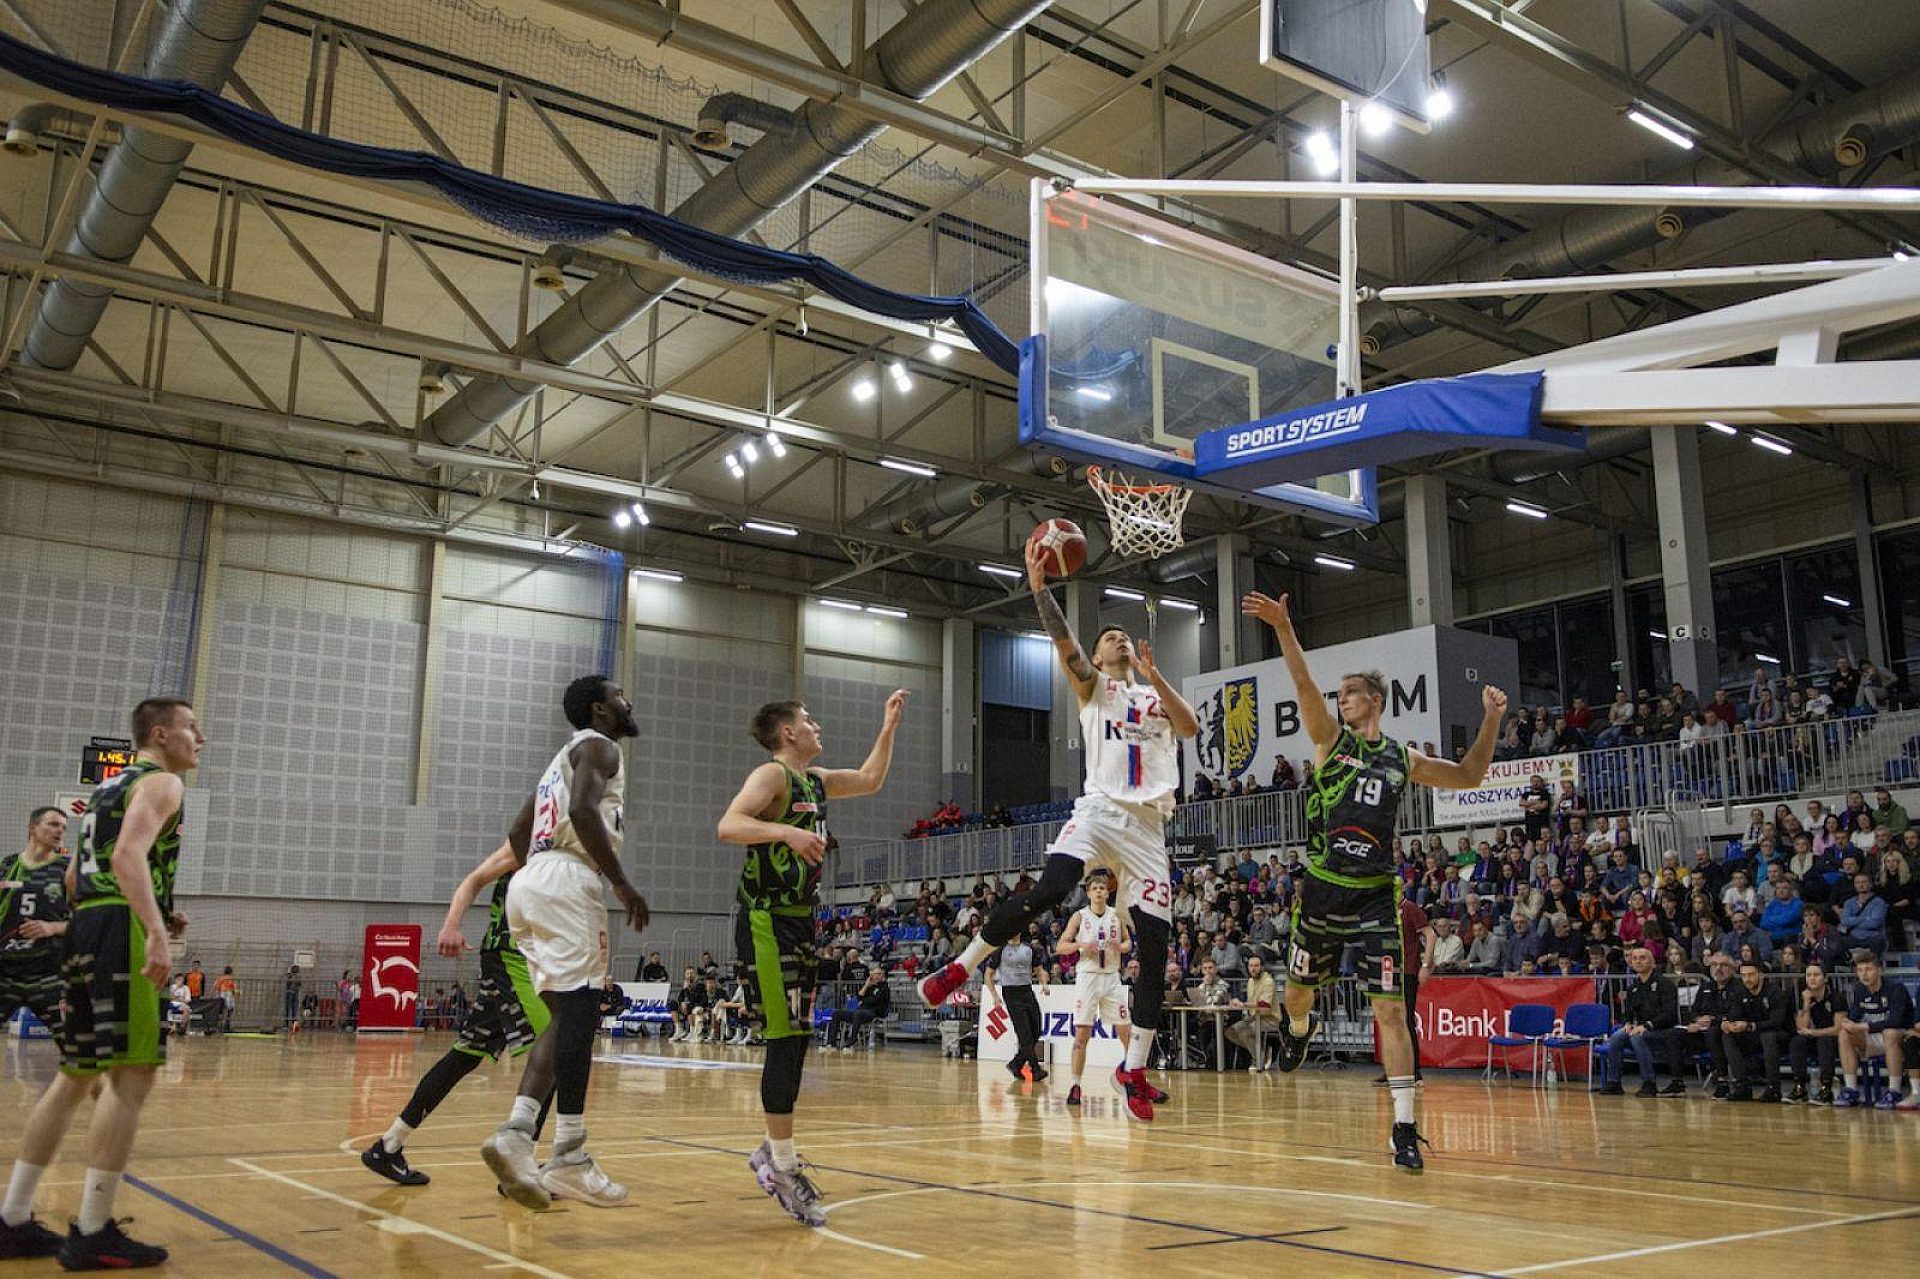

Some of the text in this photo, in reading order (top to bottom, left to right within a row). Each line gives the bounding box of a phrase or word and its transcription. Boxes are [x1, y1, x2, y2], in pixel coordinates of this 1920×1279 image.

[1354, 776, 1383, 807] 19
[1332, 836, 1373, 858] PGE
[19, 893, 37, 916] 5
[1142, 878, 1170, 908] 23
[1289, 942, 1310, 977] 19
[1438, 1008, 1497, 1038] Bank
